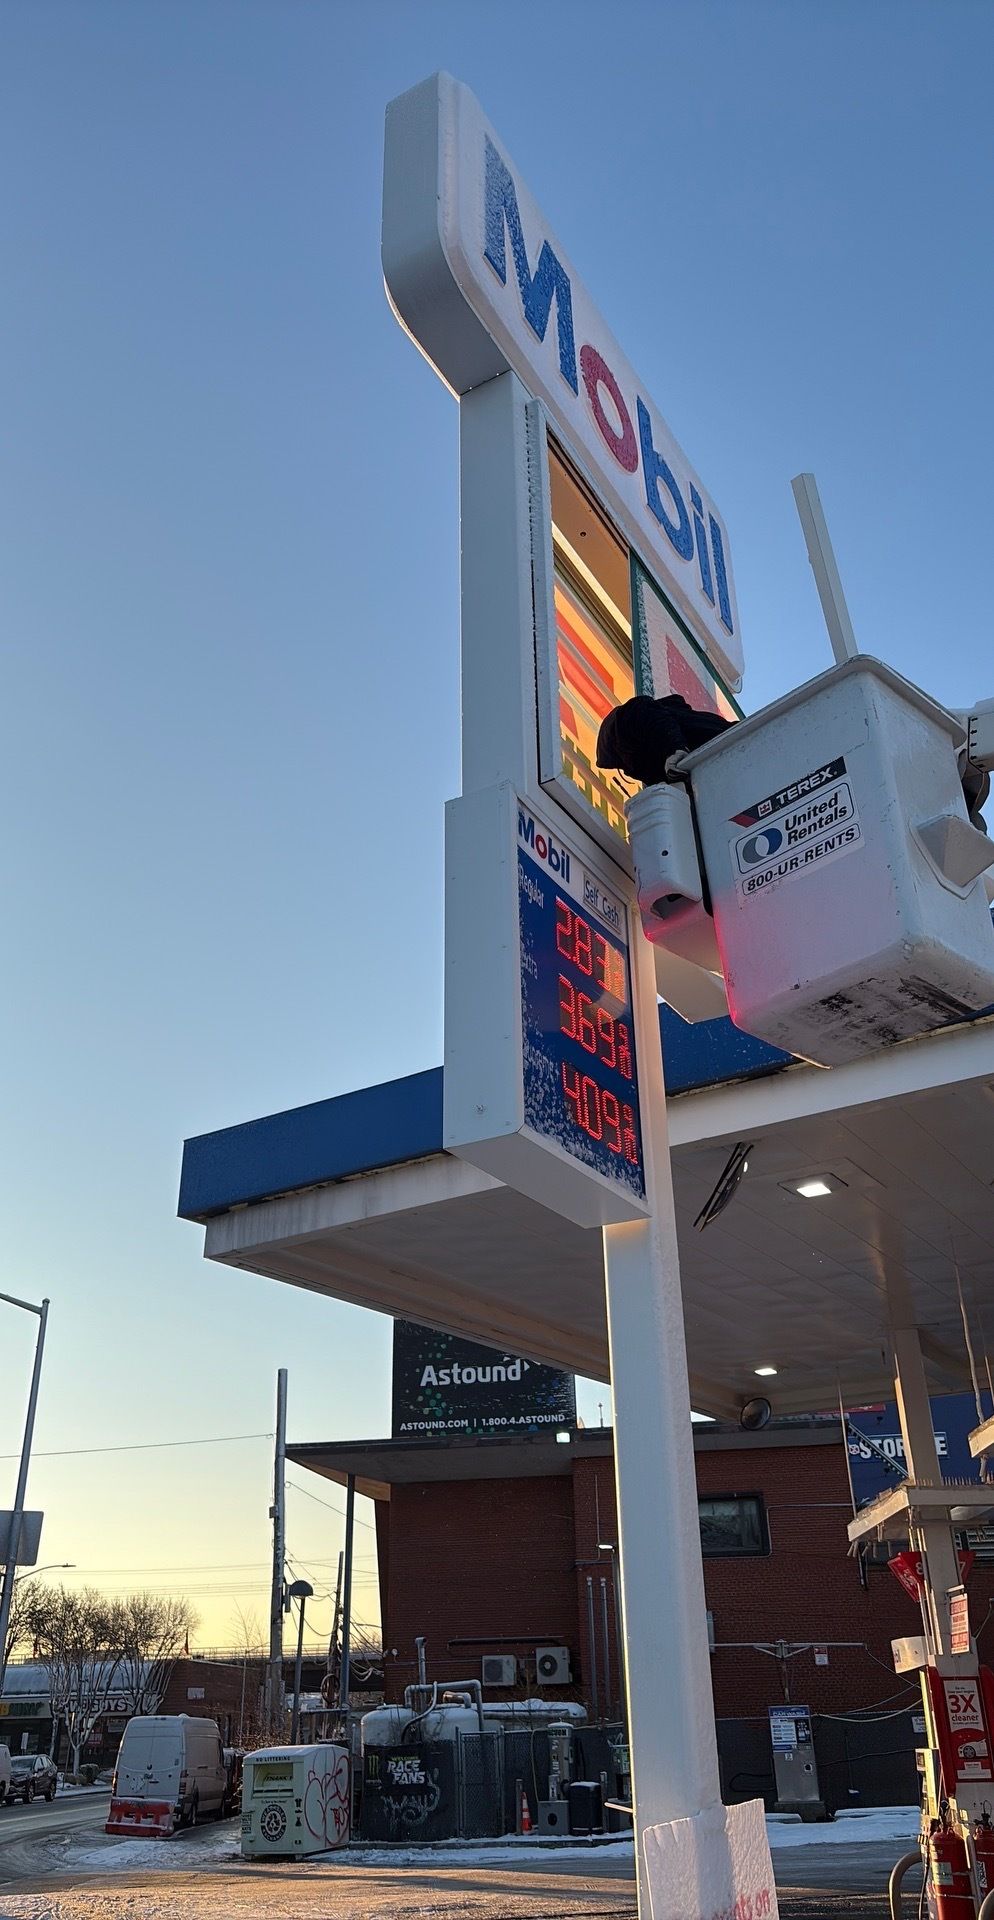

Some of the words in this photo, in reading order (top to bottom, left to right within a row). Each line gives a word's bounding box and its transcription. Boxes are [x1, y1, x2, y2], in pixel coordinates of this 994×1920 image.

[485, 132, 733, 636] Mobil
[776, 767, 833, 805] TEREX
[785, 792, 839, 831] United
[787, 805, 848, 845] Rentals
[518, 811, 570, 884] Mobil
[747, 828, 855, 891] 800-UR-RENTS
[519, 863, 544, 909] Regular
[585, 880, 600, 904] Self
[602, 893, 619, 928] Cash
[420, 1359, 521, 1387] Astound
[400, 1418, 469, 1431] ASTOUND.COM
[481, 1414, 566, 1427] 1.800.4.ASTOUND
[859, 1437, 948, 1459] STORE
[949, 1694, 977, 1713] 3X
[387, 1760, 421, 1773] RACE
[392, 1771, 426, 1785] FANS
